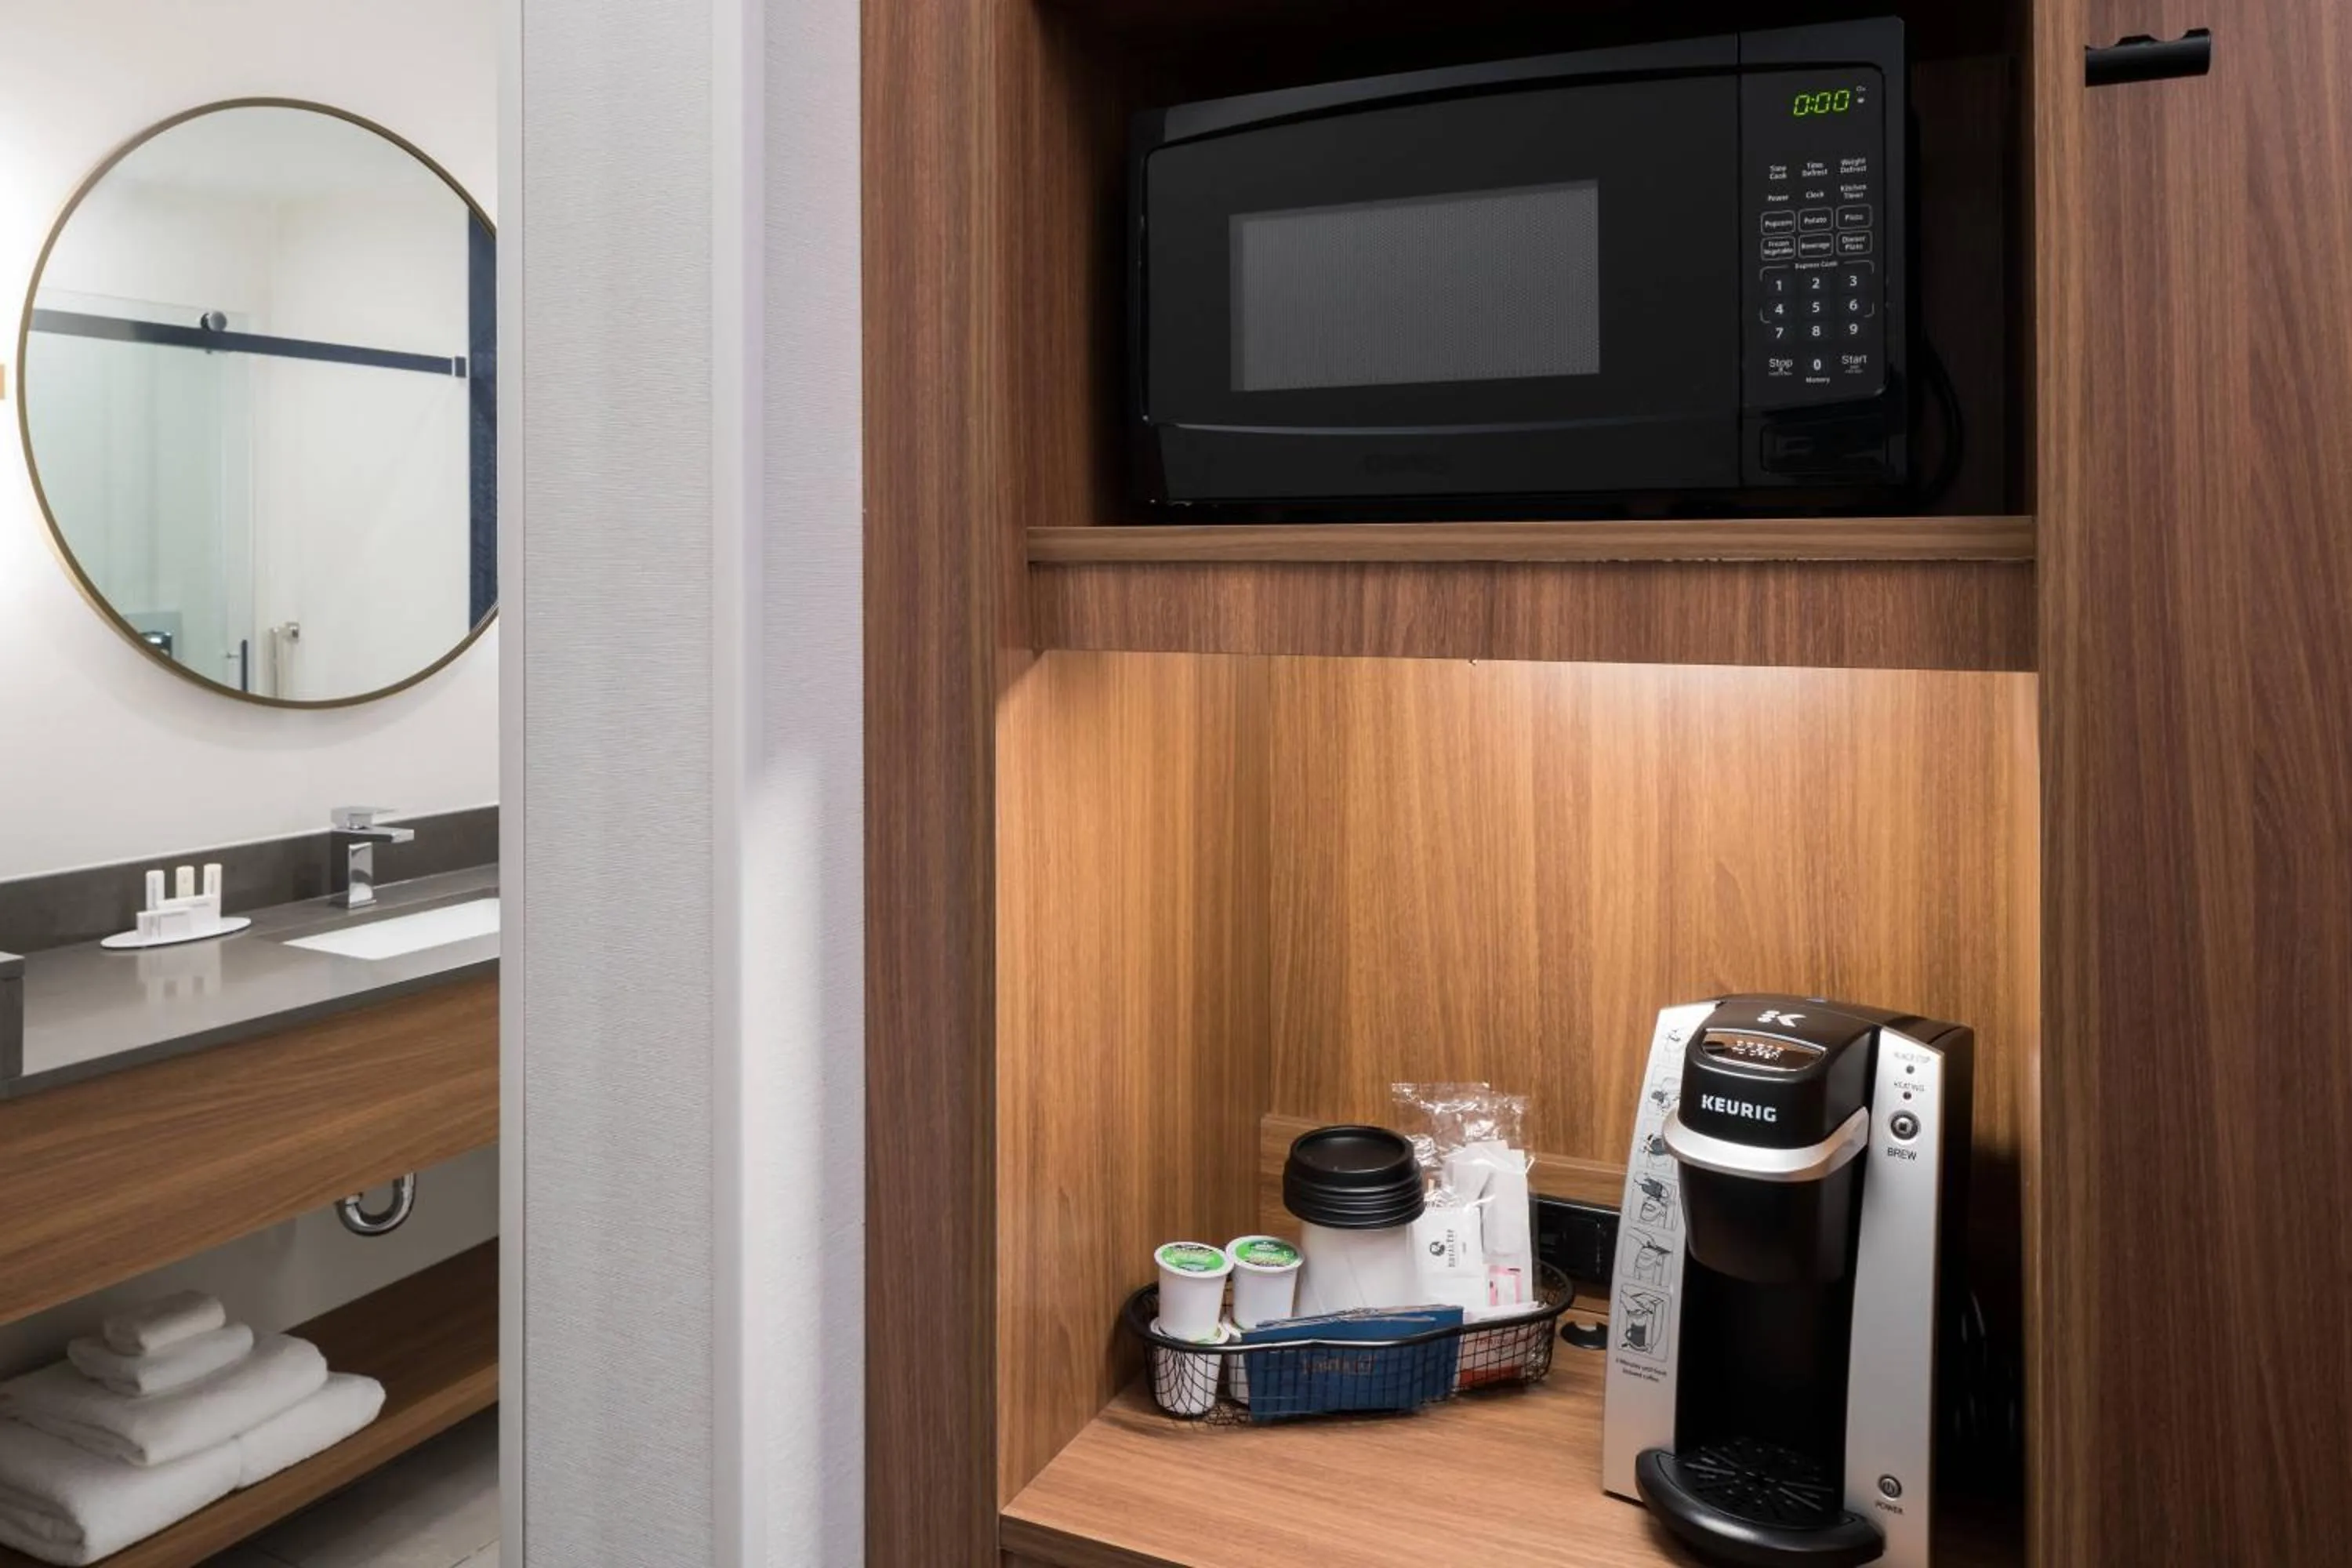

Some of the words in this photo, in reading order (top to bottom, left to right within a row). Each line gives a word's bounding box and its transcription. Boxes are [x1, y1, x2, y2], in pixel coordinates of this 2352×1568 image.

[1793, 89, 1850, 116] 0:00
[1806, 191, 1824, 199] Clock
[1803, 216, 1828, 225] Potato
[1775, 279, 1783, 291] 1
[1812, 278, 1820, 289] 2
[1849, 275, 1857, 287] 3
[1774, 303, 1784, 314] 4
[1812, 302, 1820, 313] 5
[1849, 299, 1857, 311] 6
[1775, 327, 1784, 339] 7
[1812, 325, 1820, 337] 8
[1849, 324, 1858, 335] 9
[1769, 358, 1793, 368] Stop
[1813, 358, 1821, 371] 0
[1841, 354, 1867, 365] Start
[1700, 1093, 1777, 1123] KEURIG
[1887, 1146, 1917, 1161] BREW
